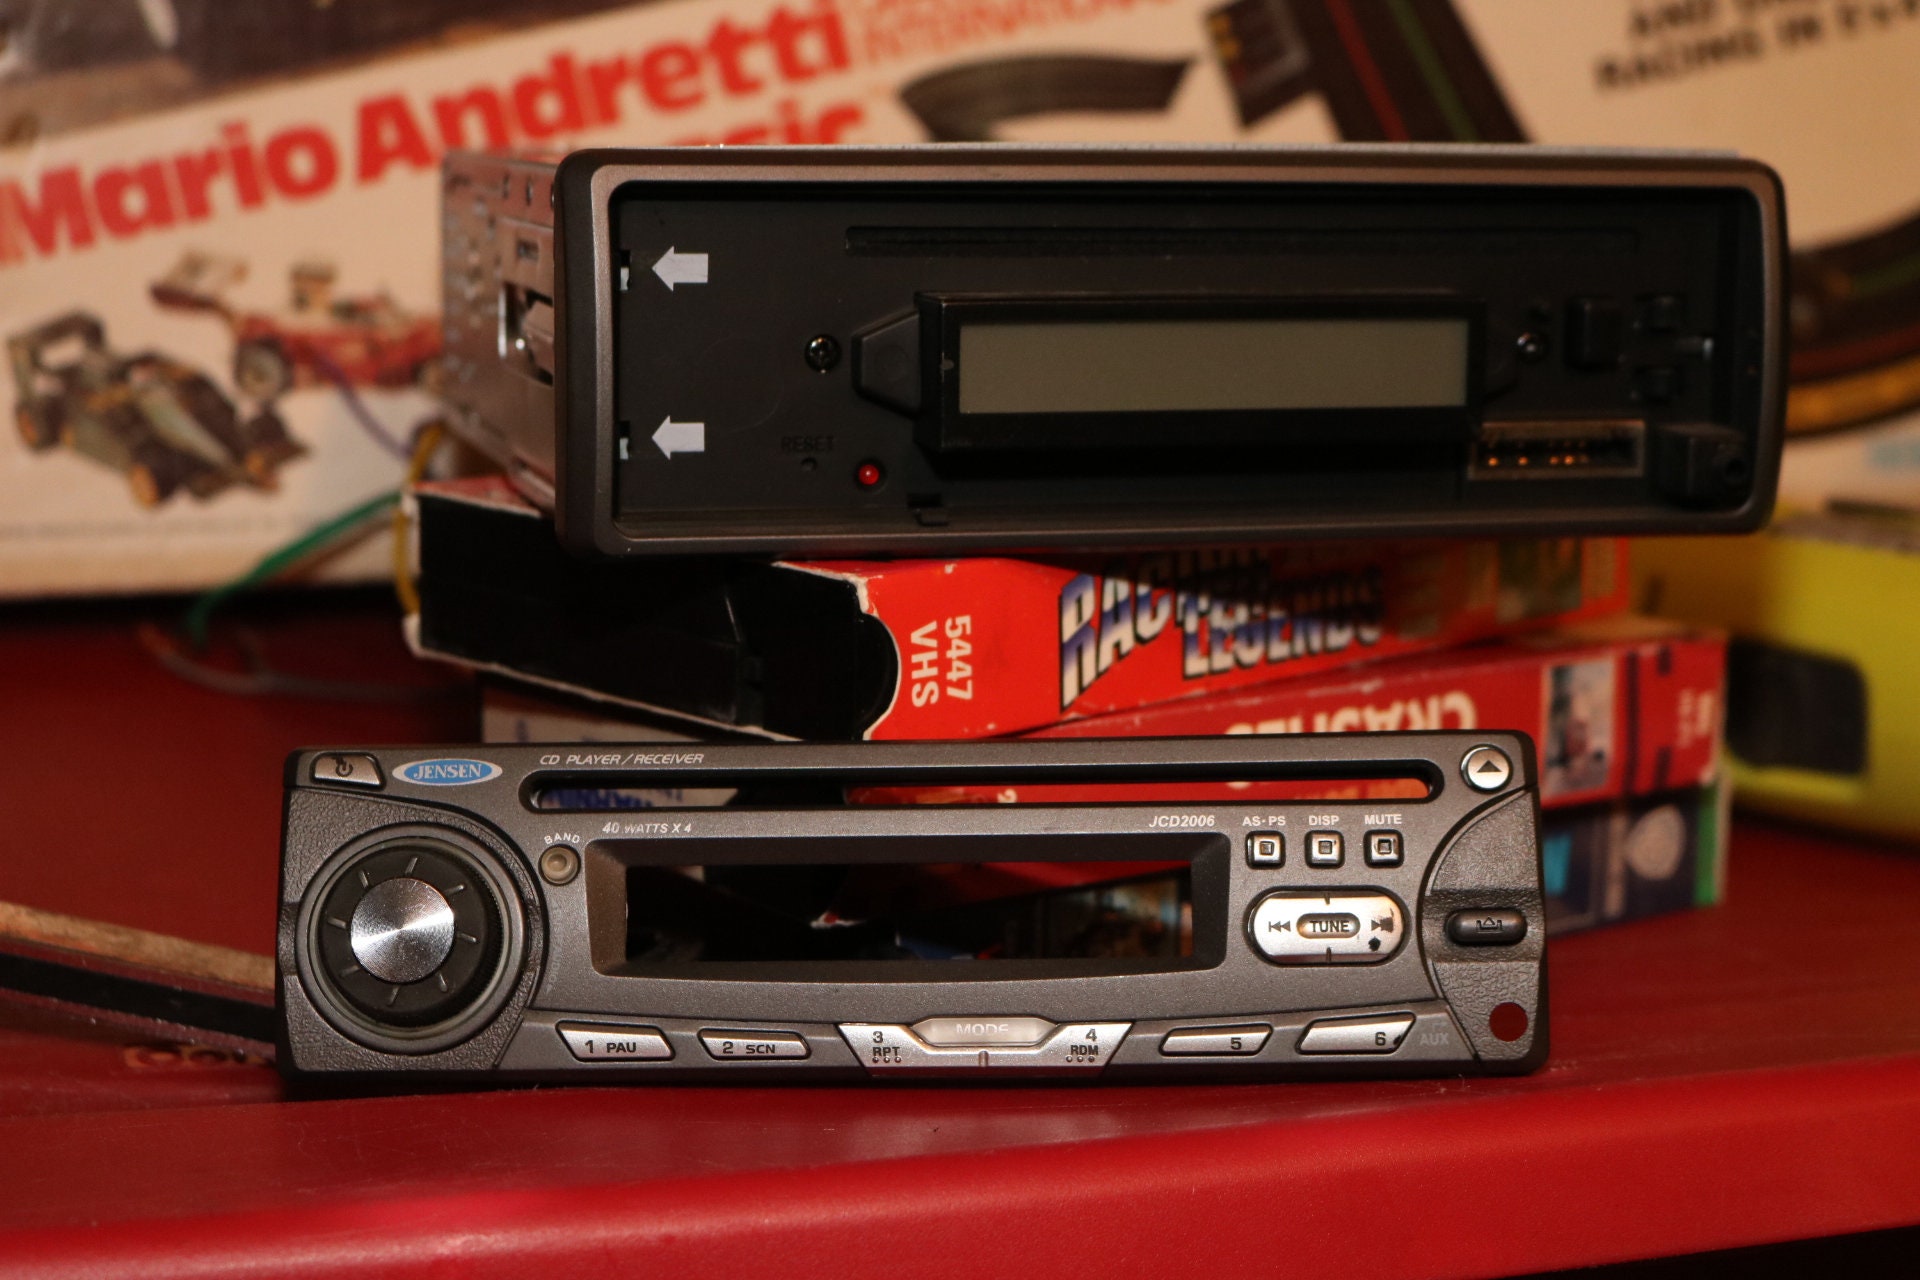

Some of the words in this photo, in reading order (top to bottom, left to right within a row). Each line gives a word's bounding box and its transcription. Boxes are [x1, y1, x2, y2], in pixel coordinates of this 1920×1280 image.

[0, 118, 340, 268] Mario
[358, 0, 851, 185] Andretti
[780, 434, 835, 453] RESET
[911, 620, 938, 708] VHS
[945, 614, 973, 701] 5447
[539, 754, 560, 766] CD
[412, 763, 483, 780] JENSEN
[1149, 815, 1216, 828] JCD2006
[1308, 815, 1340, 826] DISP
[1364, 813, 1403, 826] MUTE
[601, 821, 620, 835] 40
[624, 822, 669, 834] WATTS
[543, 832, 581, 845] BAND
[1309, 919, 1351, 934] TUNE
[872, 1030, 884, 1044] 3
[1085, 1028, 1098, 1042] 4
[1374, 1031, 1387, 1047] 6
[1419, 1033, 1450, 1046] AUX
[584, 1039, 595, 1054] 1
[606, 1041, 637, 1054] PAU
[722, 1041, 735, 1055] 2
[745, 1044, 777, 1055] SCN
[1070, 1045, 1100, 1056] RDM
[1230, 1037, 1243, 1051] 5
[872, 1046, 901, 1057] RPT
